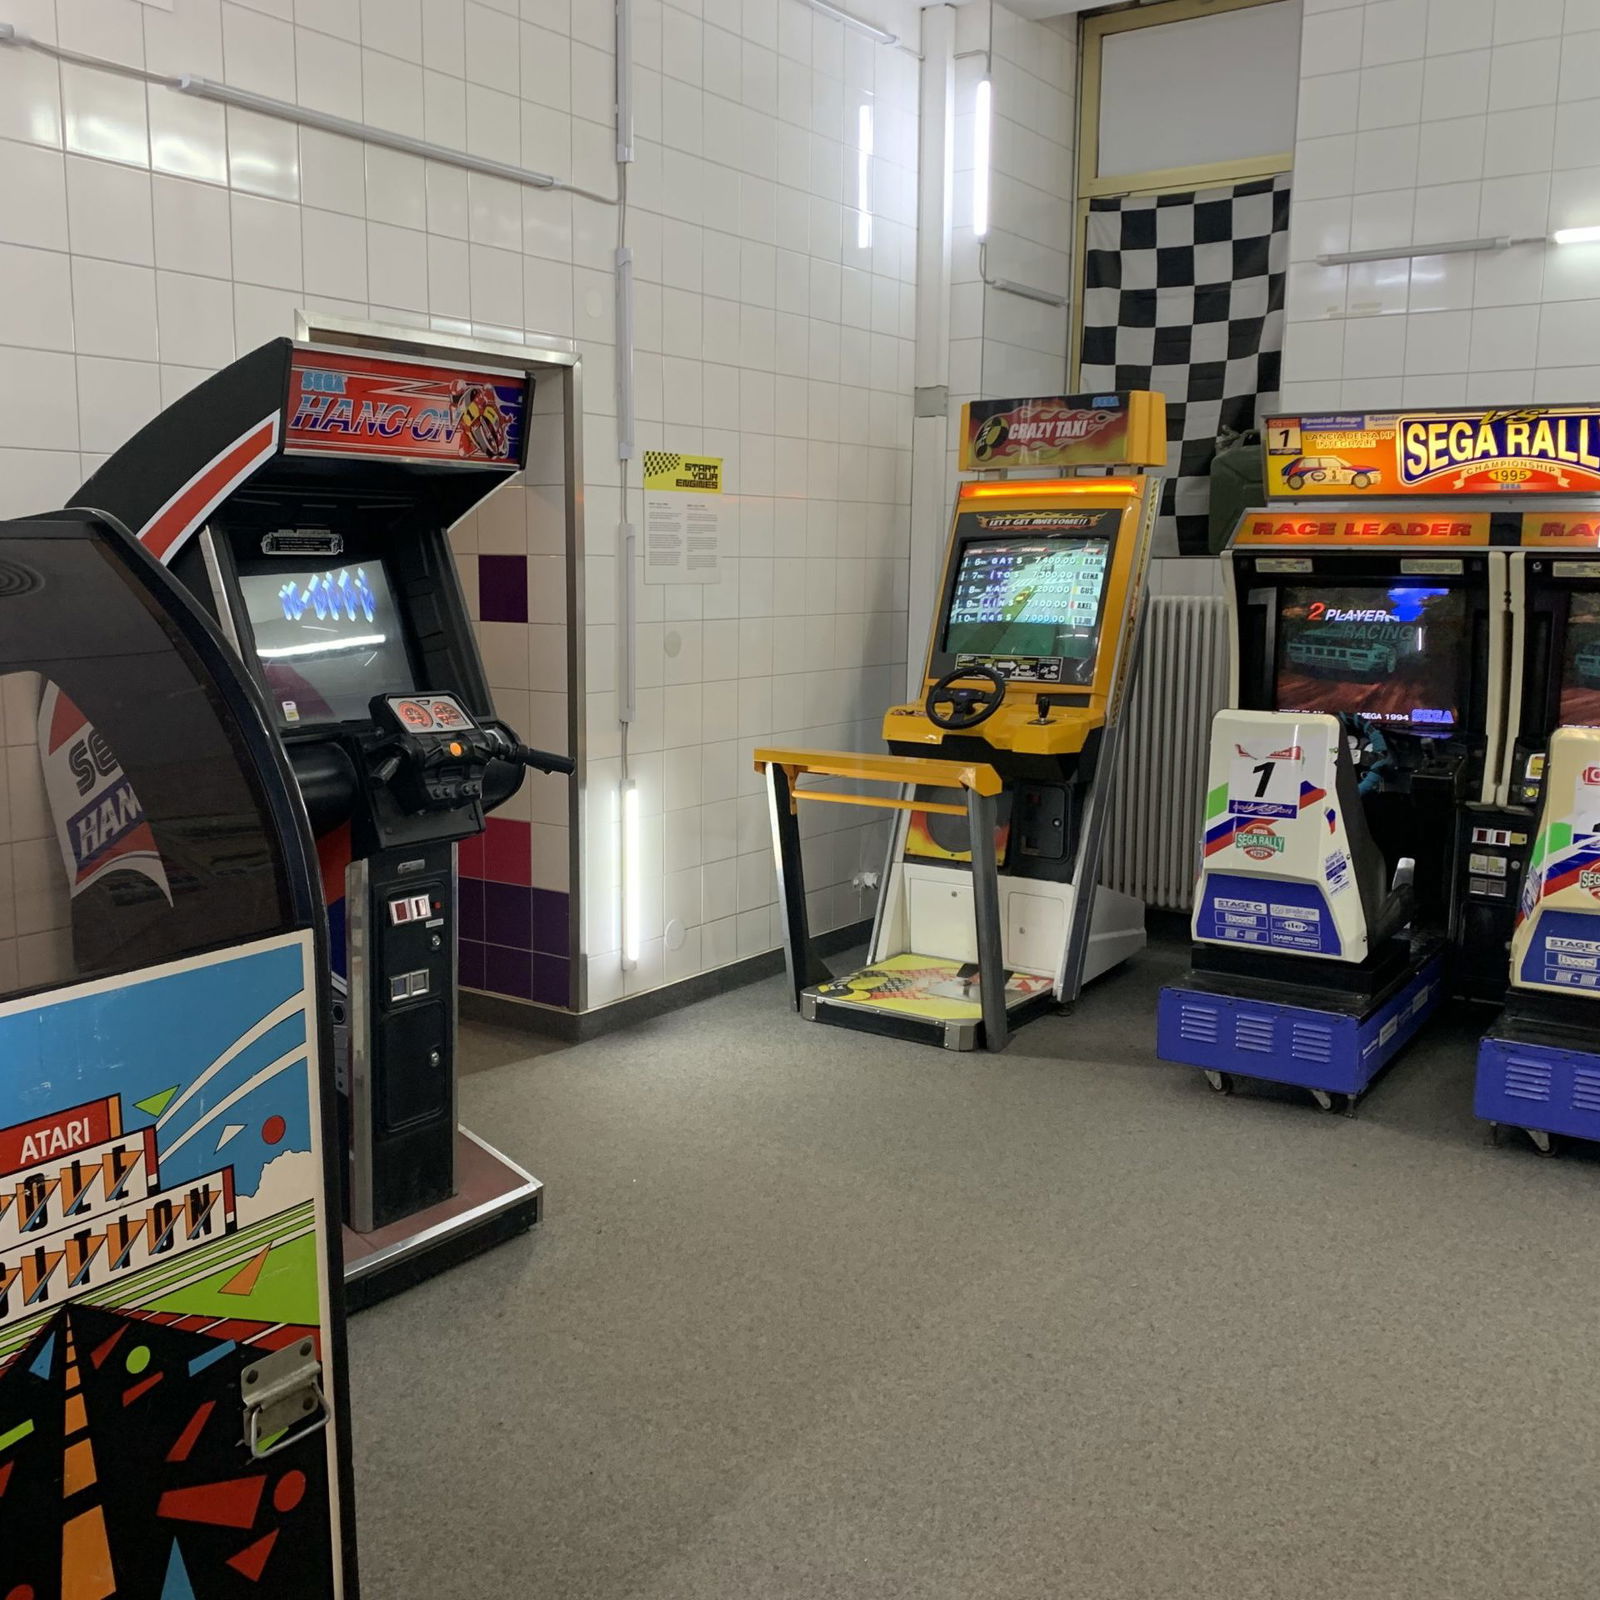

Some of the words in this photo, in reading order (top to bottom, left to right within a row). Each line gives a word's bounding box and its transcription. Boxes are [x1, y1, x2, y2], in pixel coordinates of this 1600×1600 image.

[302, 371, 347, 394] SEGA
[1008, 421, 1054, 440] CRAZY
[1055, 419, 1089, 437] TAXI
[1305, 432, 1345, 441] LANCIA
[1347, 431, 1379, 441] DELTA
[1279, 429, 1290, 448] 1
[1406, 422, 1499, 476] SEGA
[1507, 418, 1600, 469] RALL
[685, 463, 718, 473] START
[1466, 460, 1557, 476] CHAMPIONSHIP
[1494, 469, 1528, 482] 1995
[675, 479, 718, 489] ENGINES
[692, 472, 718, 481] YOUR
[1252, 522, 1336, 537] RACE
[1344, 522, 1472, 537] LEADER
[1307, 602, 1326, 620] 2
[1325, 609, 1387, 621] PLAYER
[1385, 713, 1409, 721] 1994
[1411, 708, 1454, 723] SEGA
[1252, 762, 1276, 797] 1
[1236, 833, 1258, 847] SEGA
[1258, 836, 1285, 852] RALLY
[1217, 899, 1250, 909] STAGE
[1550, 939, 1593, 950] STAGE
[19, 1117, 91, 1165] ATARI
